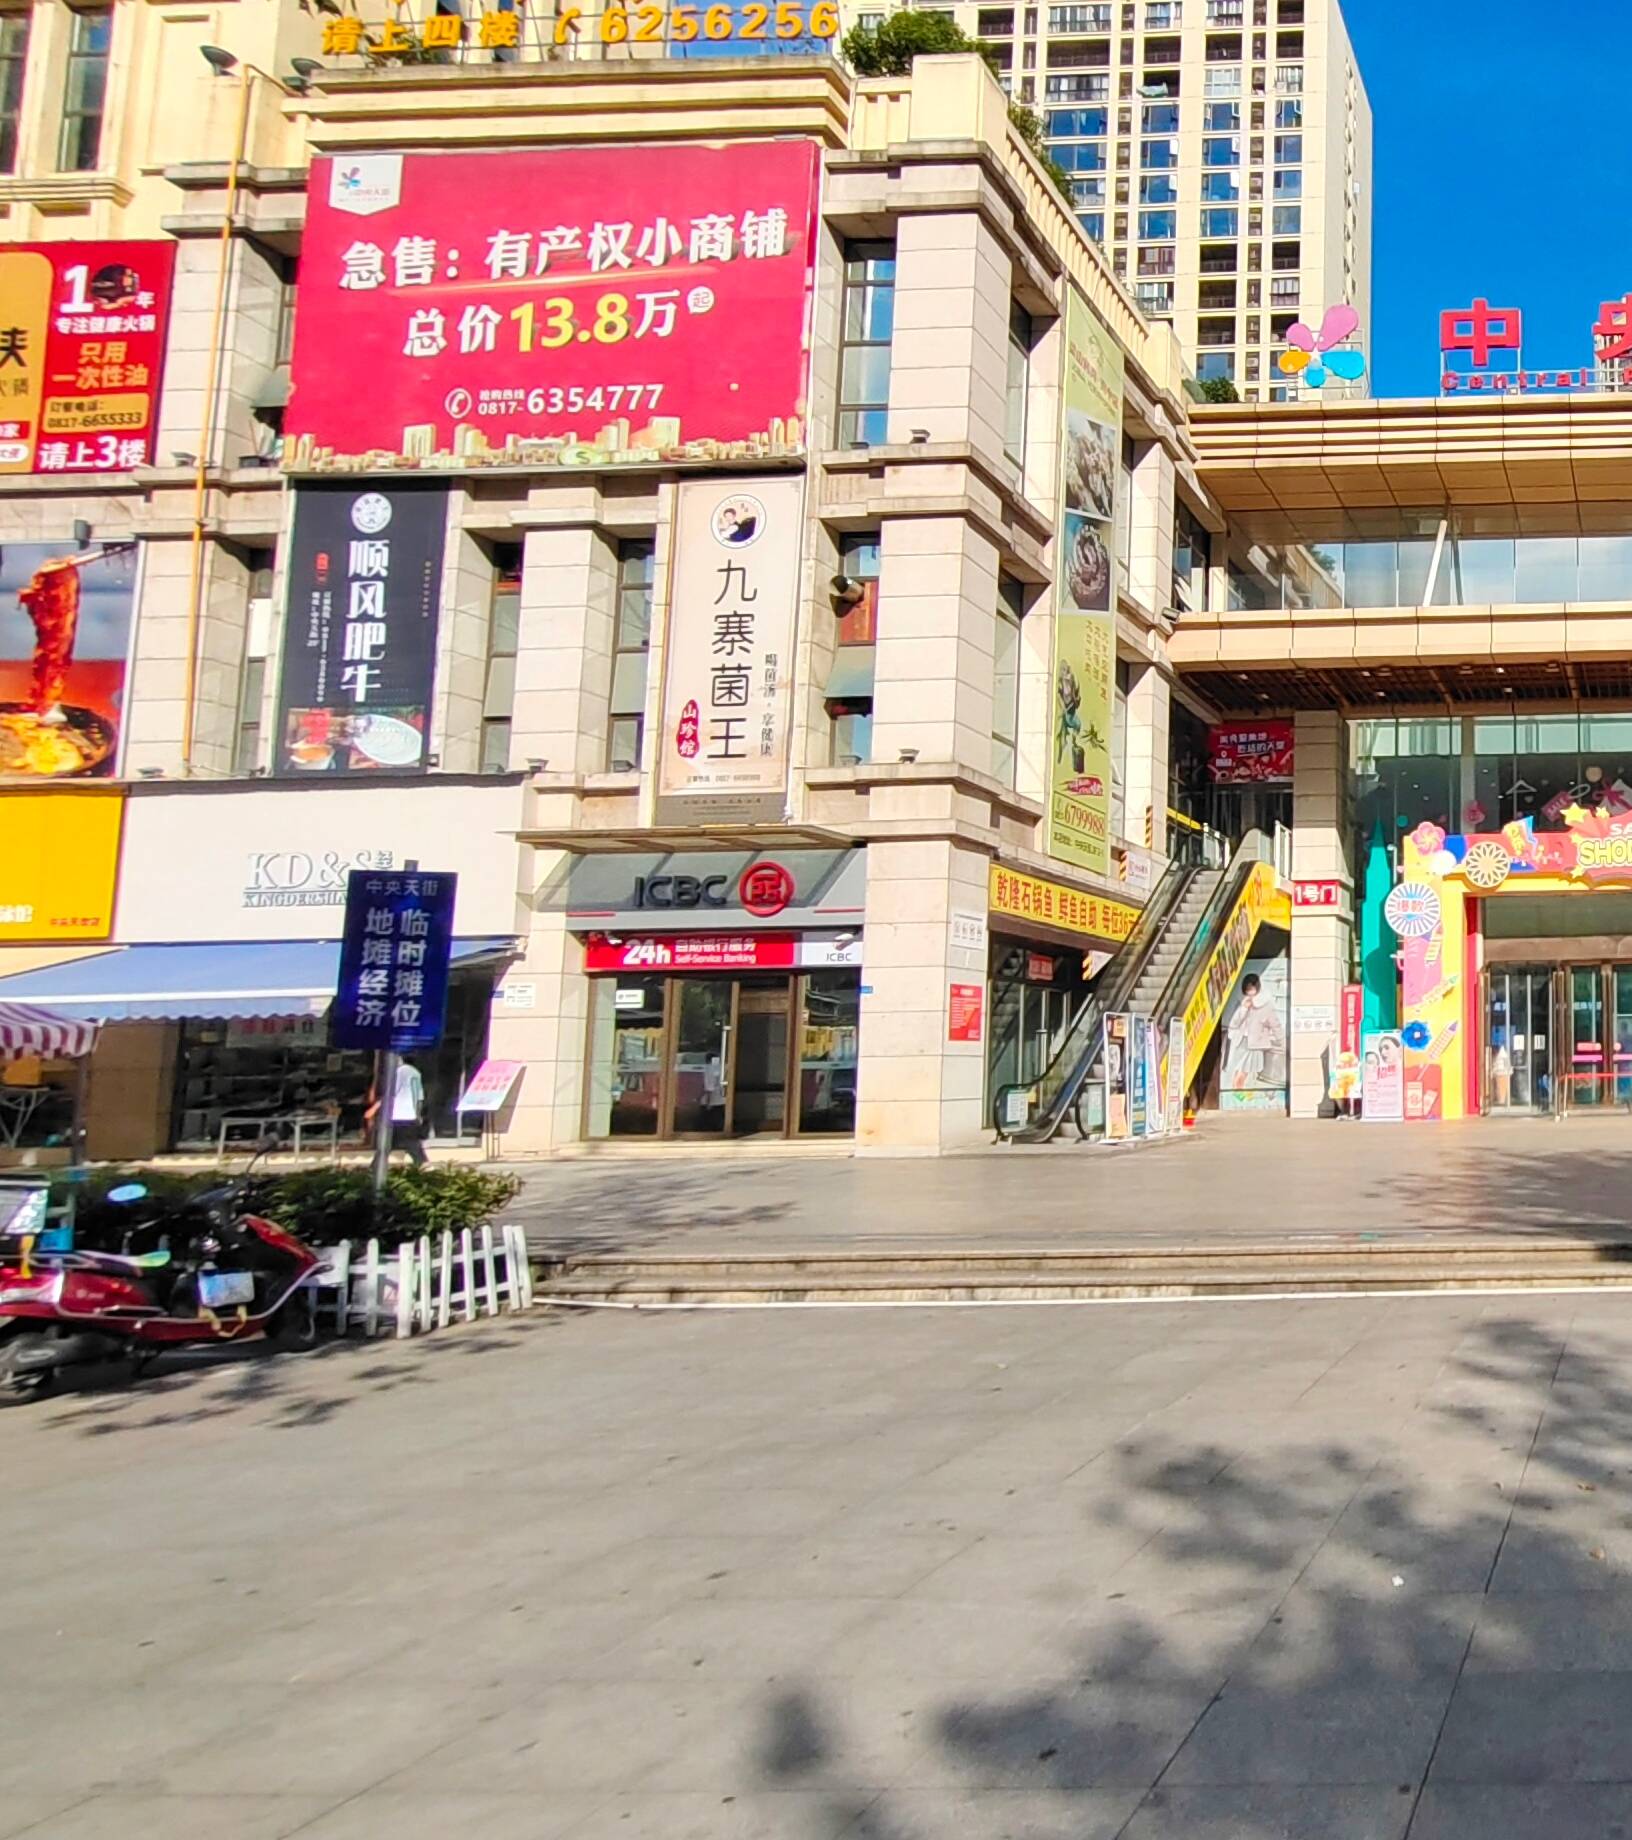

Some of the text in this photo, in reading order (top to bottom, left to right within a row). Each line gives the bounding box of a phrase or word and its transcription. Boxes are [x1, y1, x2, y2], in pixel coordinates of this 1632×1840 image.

[321, 2, 839, 54] 请上四楼 6256256
[78, 341, 128, 365] 只用
[52, 363, 149, 391] 一次性油
[1441, 368, 1587, 390] Central
[38, 435, 147, 470] 请上3楼
[340, 539, 391, 702] 顺风肥牛
[707, 559, 758, 759] 九寨菌王
[678, 703, 700, 757] 山珍馆
[365, 879, 439, 897] 中央天街
[632, 875, 728, 907] ICBC
[1294, 885, 1337, 904] 1号门
[623, 938, 671, 965] 24h
[723, 953, 757, 966] Banking
[826, 952, 853, 962] ICBC
[355, 907, 395, 1027] 地摊经济
[391, 908, 431, 1028] 临时摊位
